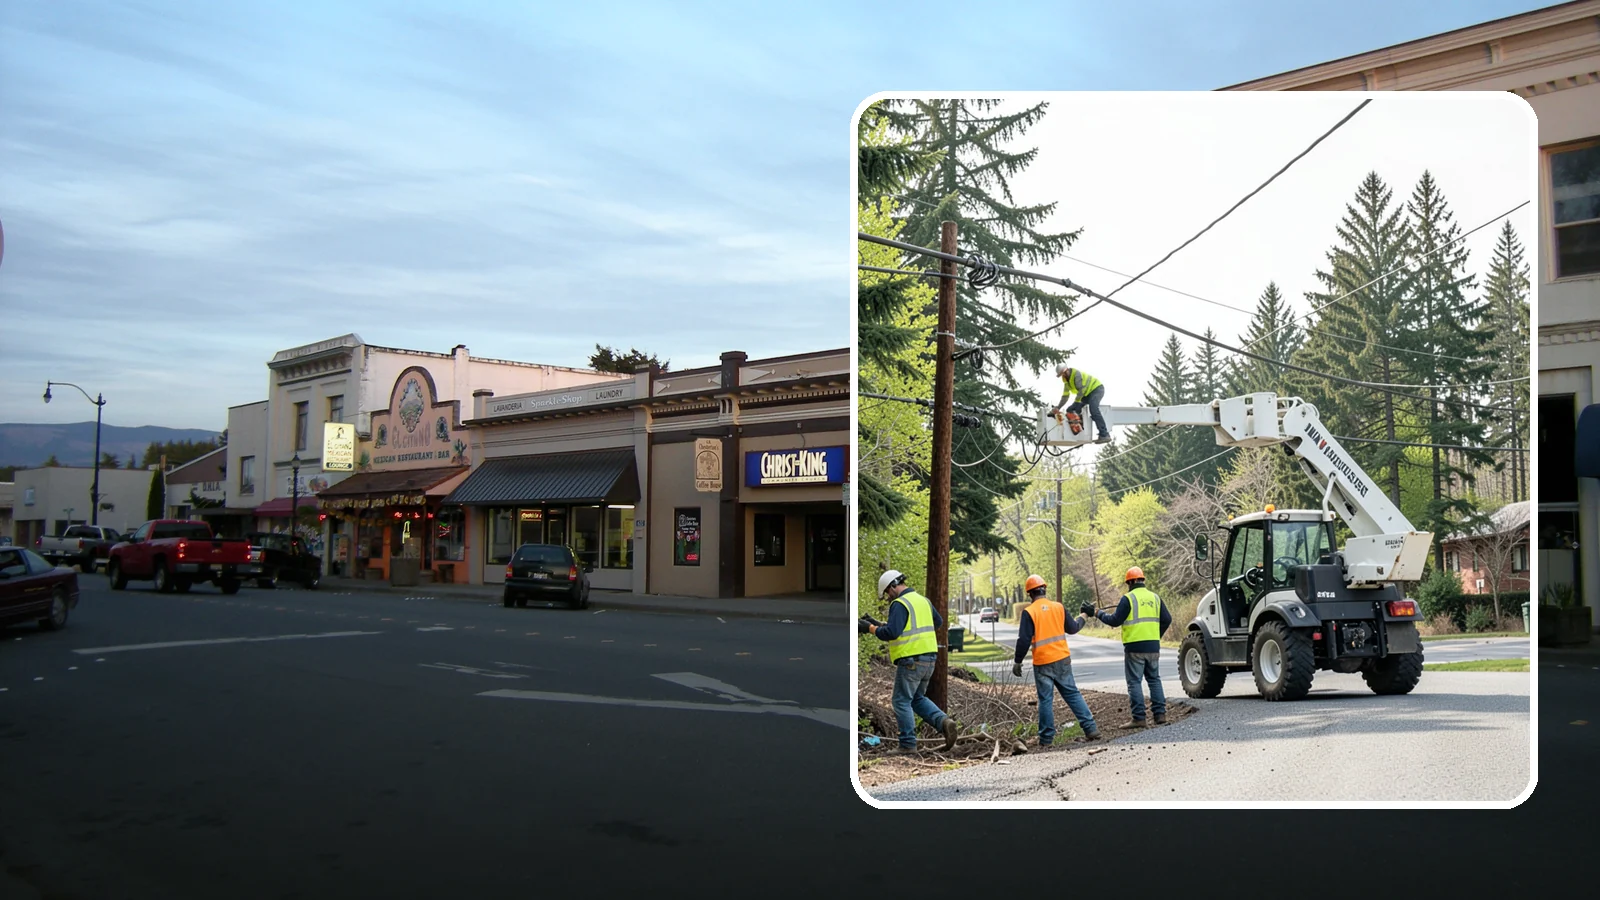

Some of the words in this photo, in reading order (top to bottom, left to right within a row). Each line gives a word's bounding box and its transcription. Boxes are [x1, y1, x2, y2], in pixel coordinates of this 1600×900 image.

[493, 401, 523, 412] LAVANDERIA
[595, 389, 624, 400] LAUNDRY
[373, 454, 396, 464] MEXICAN
[397, 451, 434, 462] RESTAURANT
[437, 450, 450, 459] BAR
[761, 452, 798, 478] CHRIST
[799, 450, 827, 476] KING
